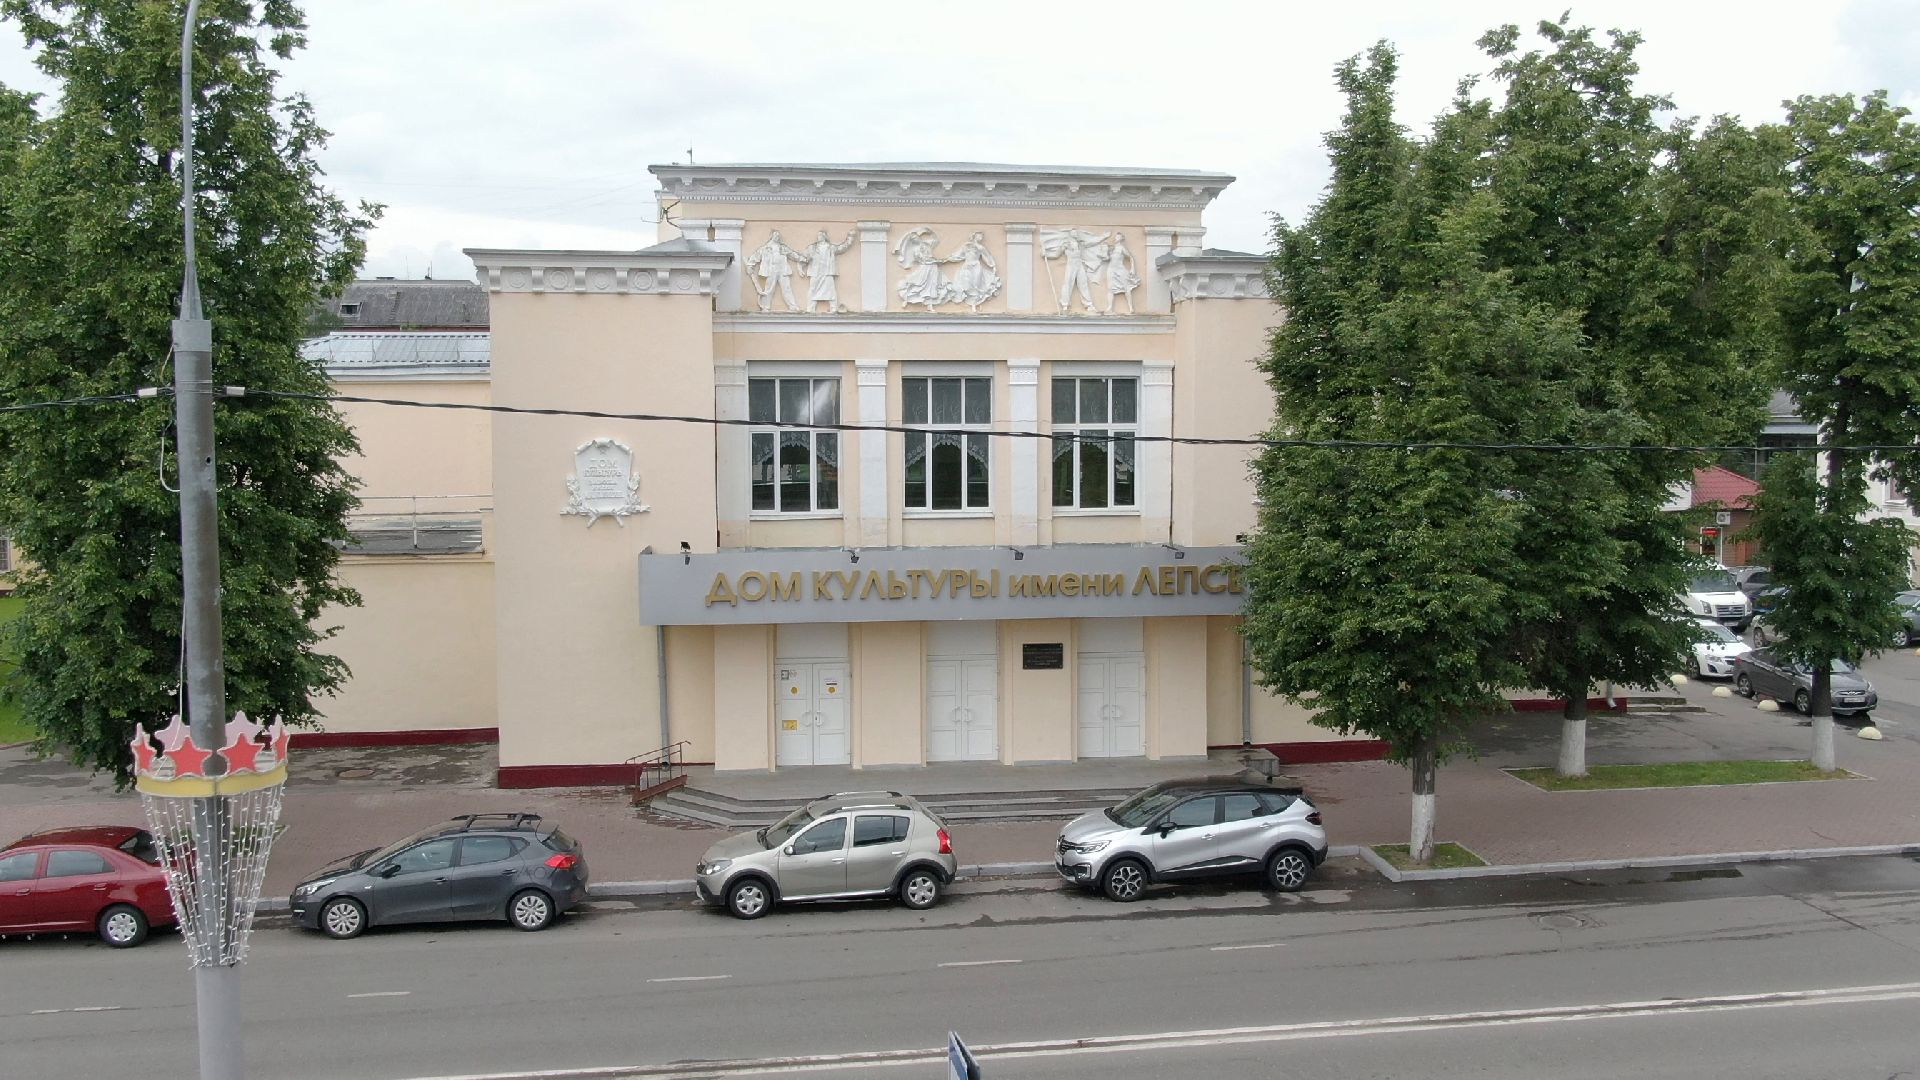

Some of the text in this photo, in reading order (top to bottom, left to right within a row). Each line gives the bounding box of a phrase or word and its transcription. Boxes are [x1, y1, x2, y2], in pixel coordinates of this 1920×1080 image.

[705, 571, 800, 607] ДОМ
[812, 569, 1000, 600] КУЛЬТУРЫ
[1008, 572, 1125, 598] имени
